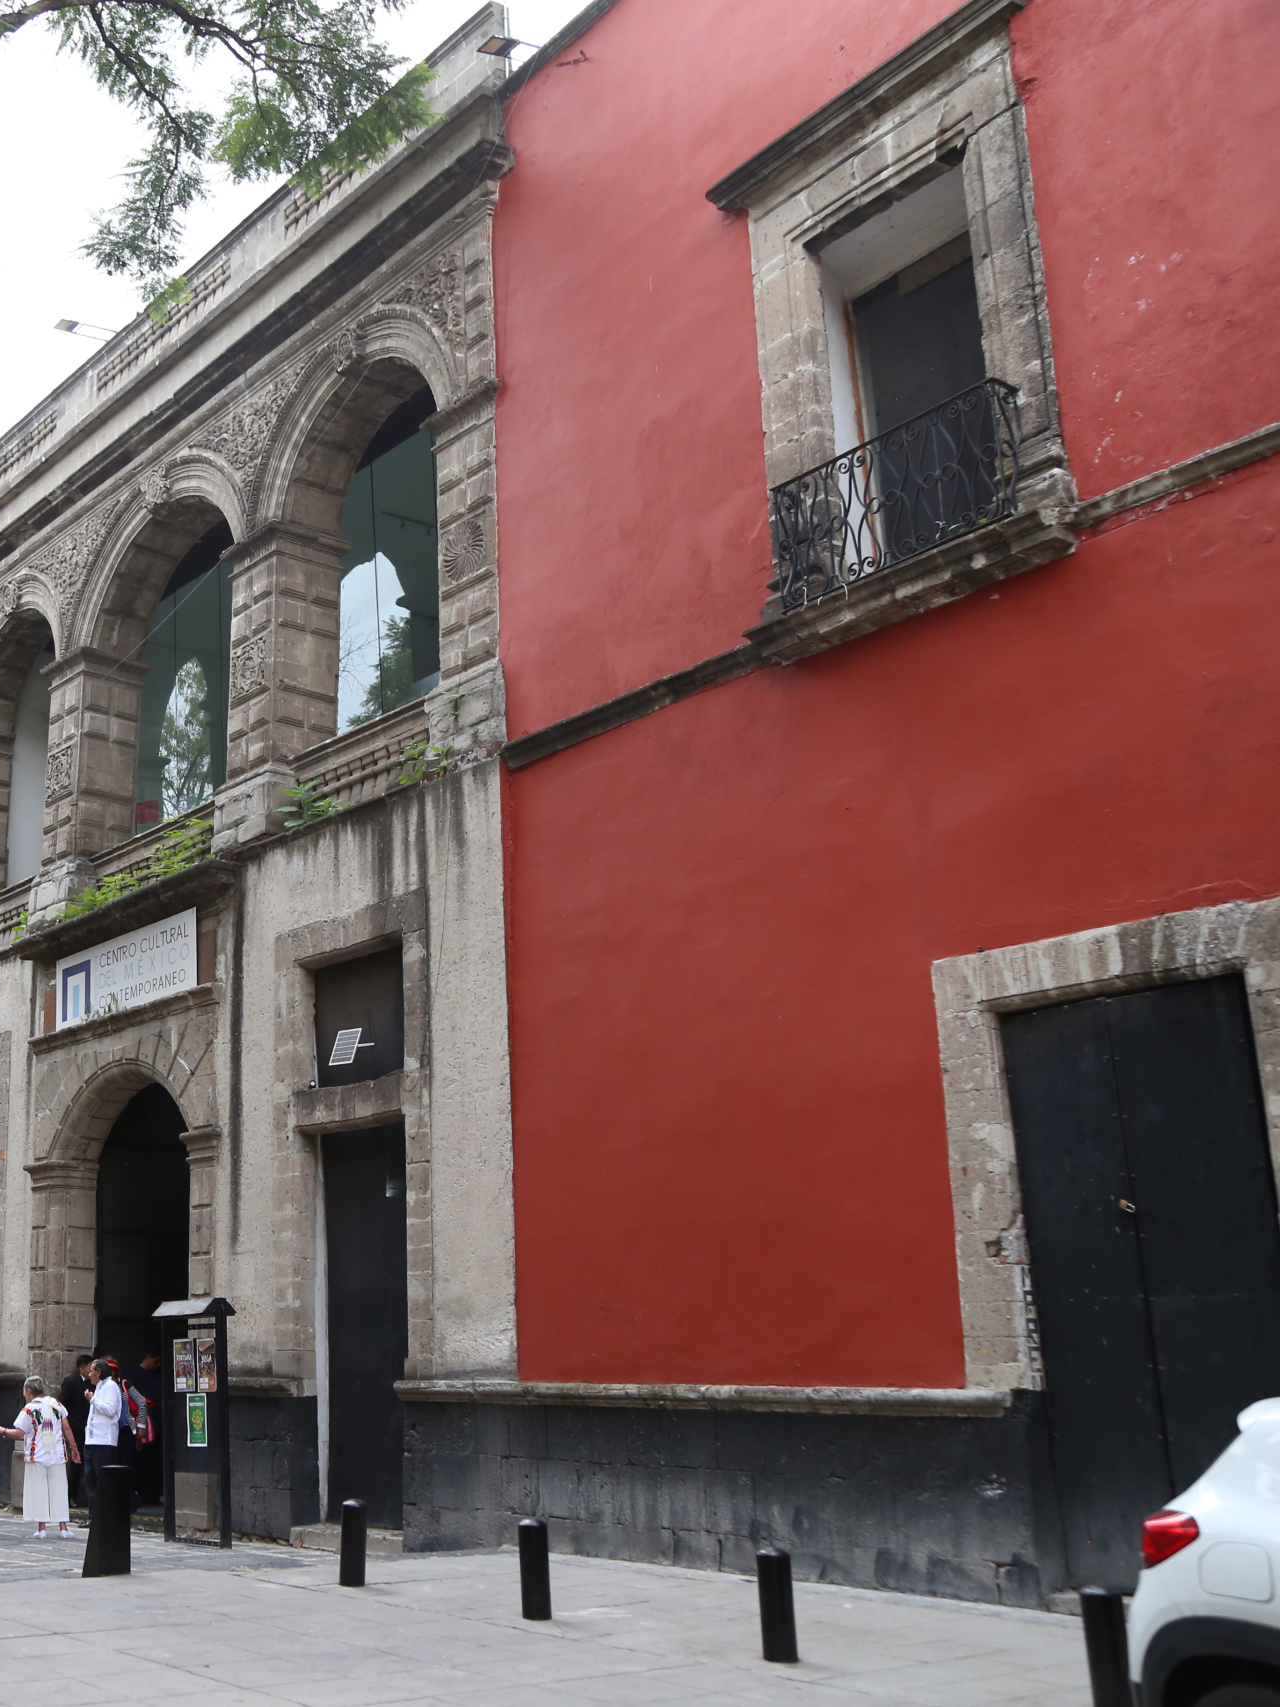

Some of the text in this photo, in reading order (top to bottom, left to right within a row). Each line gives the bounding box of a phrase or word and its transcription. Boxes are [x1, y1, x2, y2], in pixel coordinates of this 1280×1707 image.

[98, 942, 189, 990] DEL MÉXICO
[99, 923, 189, 968] CENTRO CULTURAL
[99, 968, 186, 1009] CONTEMPORANEO
[201, 1354, 212, 1363] YOGA
